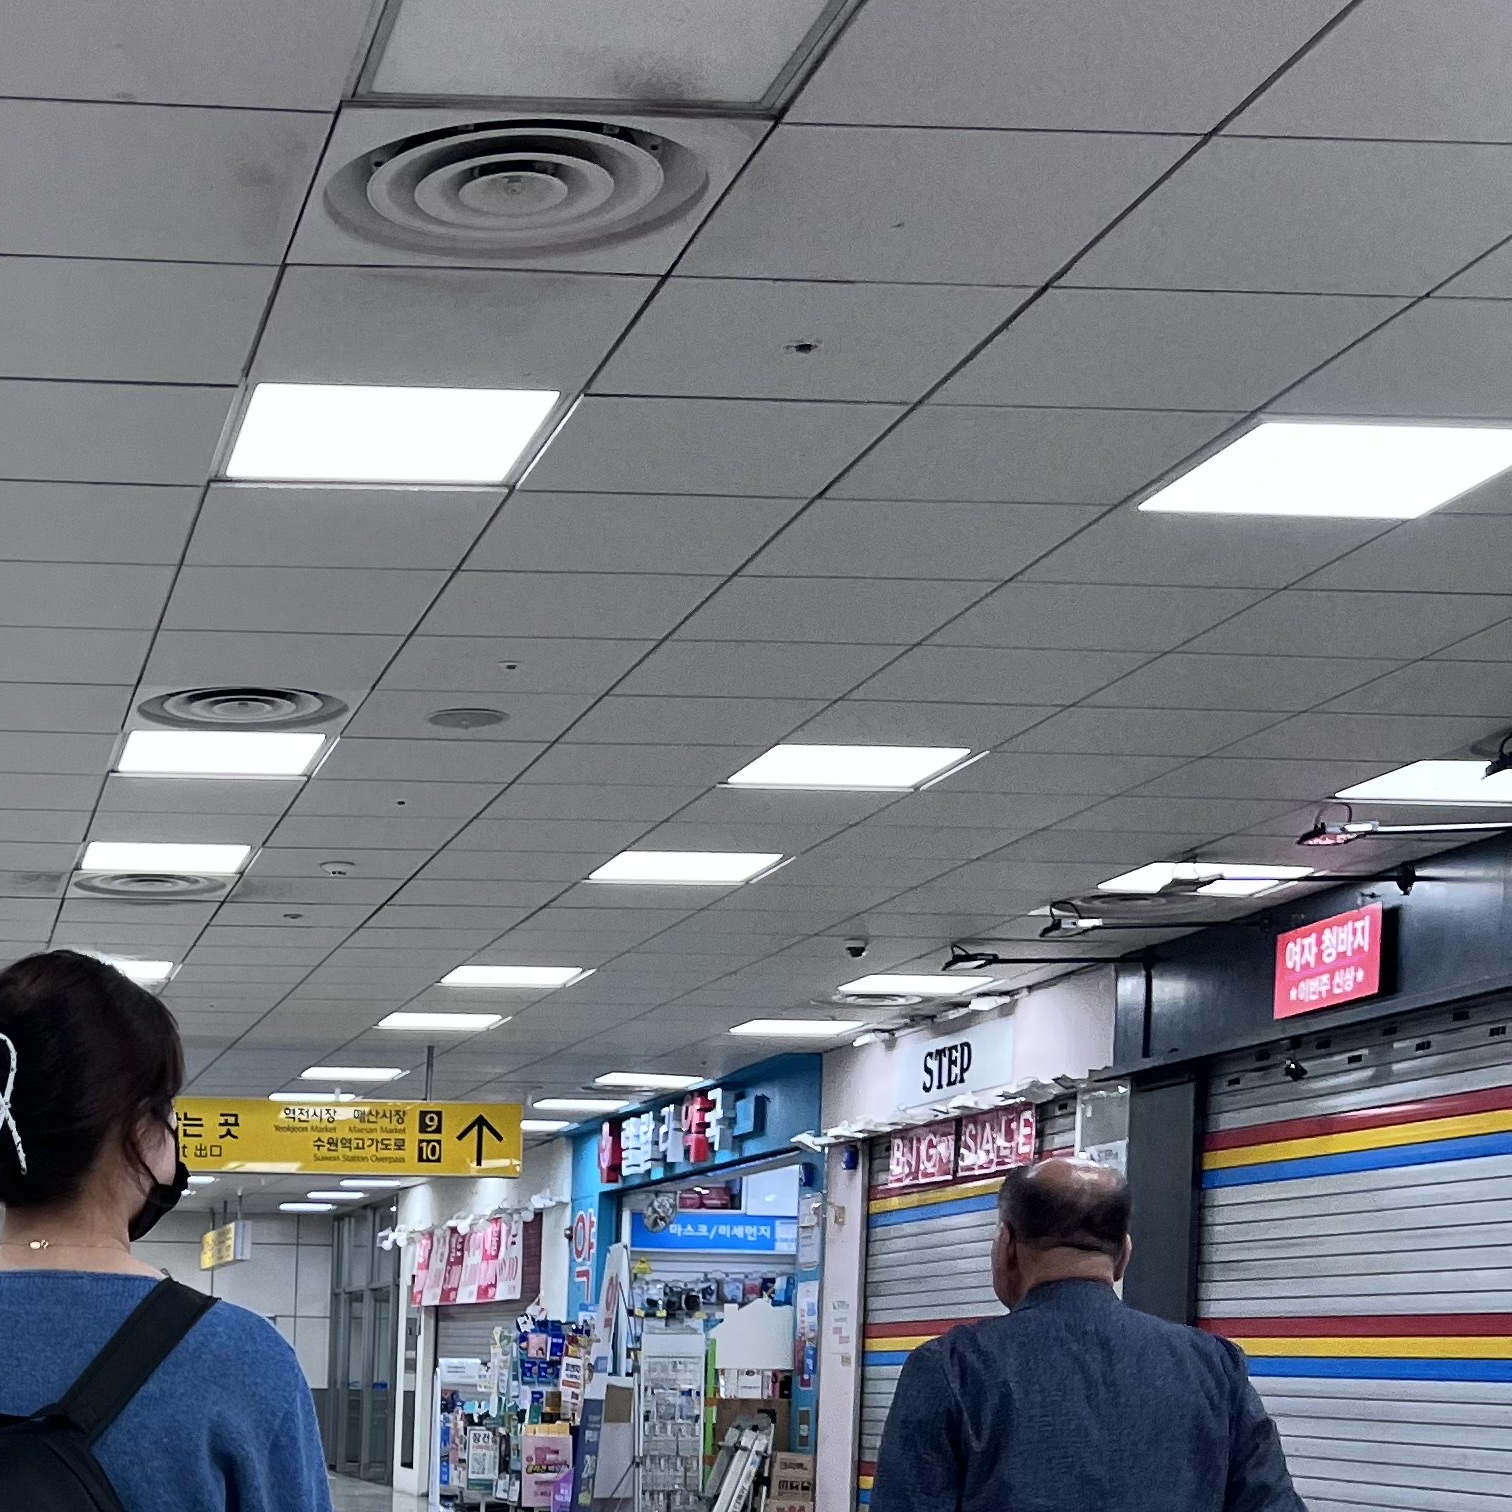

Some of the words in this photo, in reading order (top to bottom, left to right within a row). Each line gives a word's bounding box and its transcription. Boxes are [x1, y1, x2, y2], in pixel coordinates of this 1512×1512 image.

[1285, 932, 1318, 972] 여자
[1320, 915, 1371, 963] 청바지
[922, 1041, 972, 1093] STEP
[284, 1106, 337, 1124] 역전시장
[353, 1108, 407, 1125] 매산시장
[424, 1113, 438, 1132] 9
[218, 1113, 240, 1140] 곳
[310, 1124, 337, 1134] Market
[348, 1126, 378, 1135] Maesan
[379, 1126, 406, 1135] Market
[194, 1143, 223, 1158] 出口
[313, 1136, 406, 1152] 수원역고가도로
[420, 1141, 440, 1161] 10
[313, 1153, 340, 1162] Suwon
[341, 1153, 369, 1163] Station
[370, 1154, 406, 1164] Overpass
[669, 1223, 771, 1241] 마스크/미세먼지
